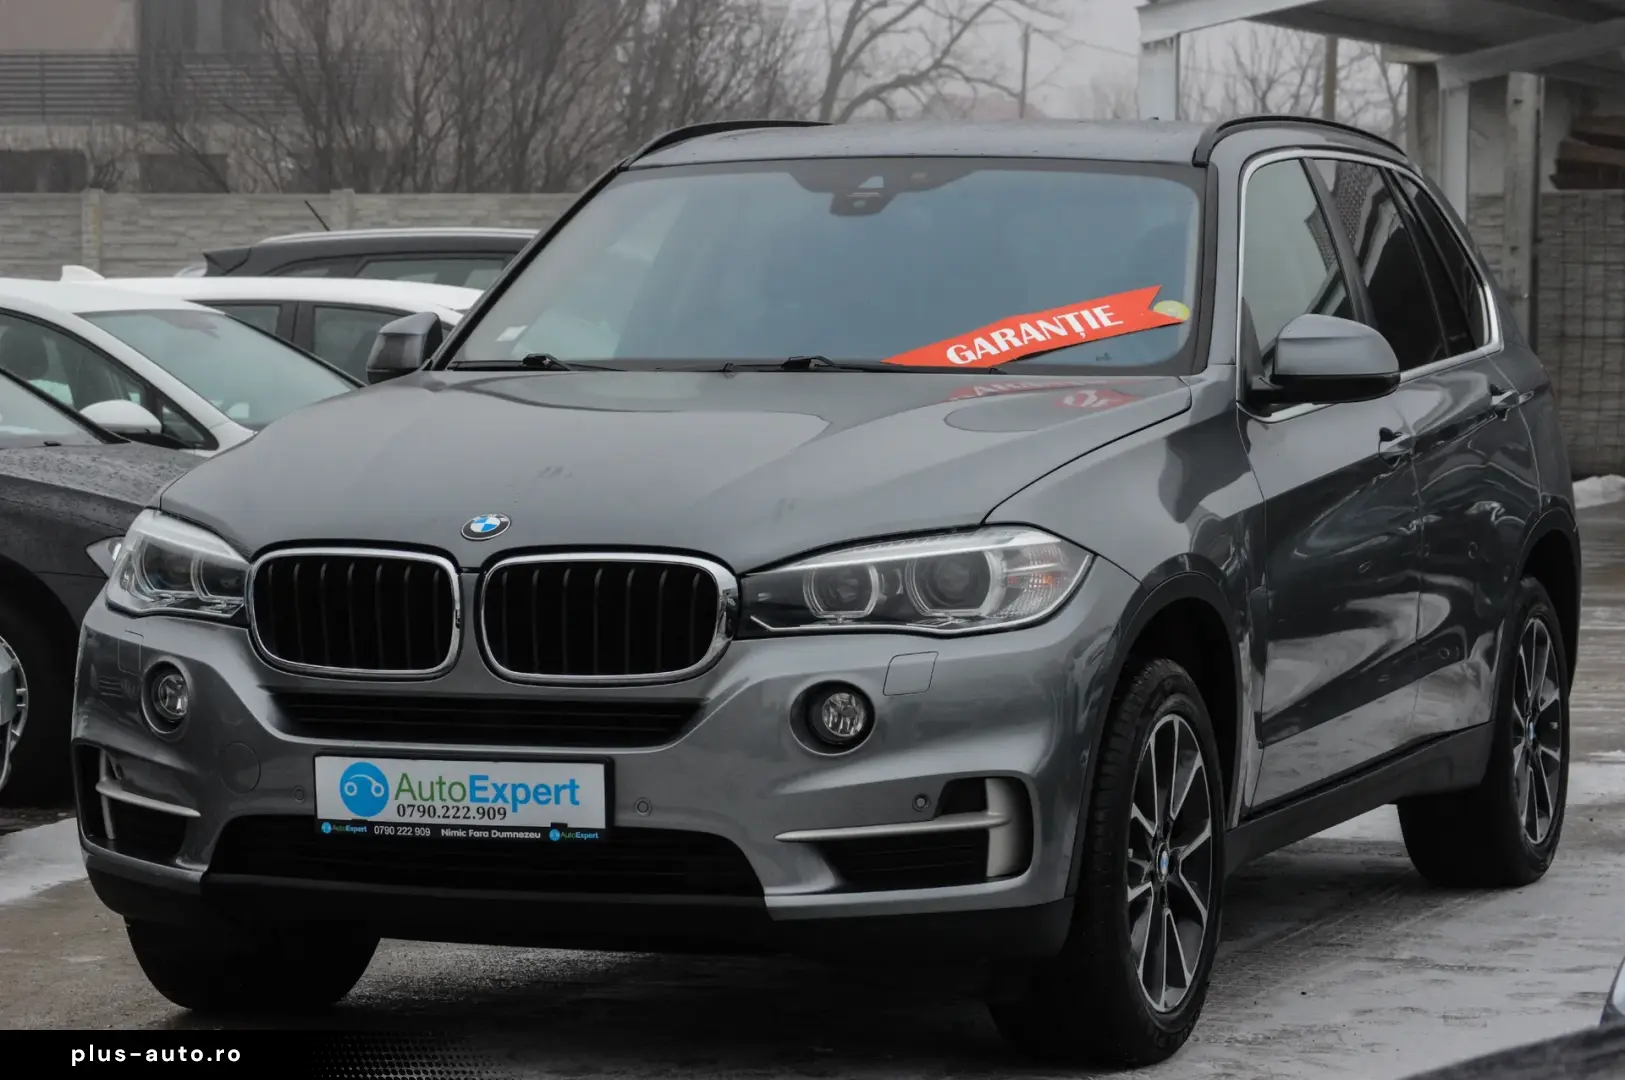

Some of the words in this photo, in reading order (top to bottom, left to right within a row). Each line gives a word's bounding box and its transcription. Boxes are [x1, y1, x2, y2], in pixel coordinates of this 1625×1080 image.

[946, 305, 1124, 365] GARANȚIE
[394, 772, 580, 812] AutoExpert
[397, 804, 507, 820] 0790.222.909
[374, 826, 395, 835] 0790
[396, 826, 413, 836] 222
[414, 827, 431, 837] 909
[441, 828, 467, 837] Nimic
[468, 829, 489, 838] Fara
[491, 830, 541, 839] Dumnezeu
[561, 831, 599, 840] AutoExpert
